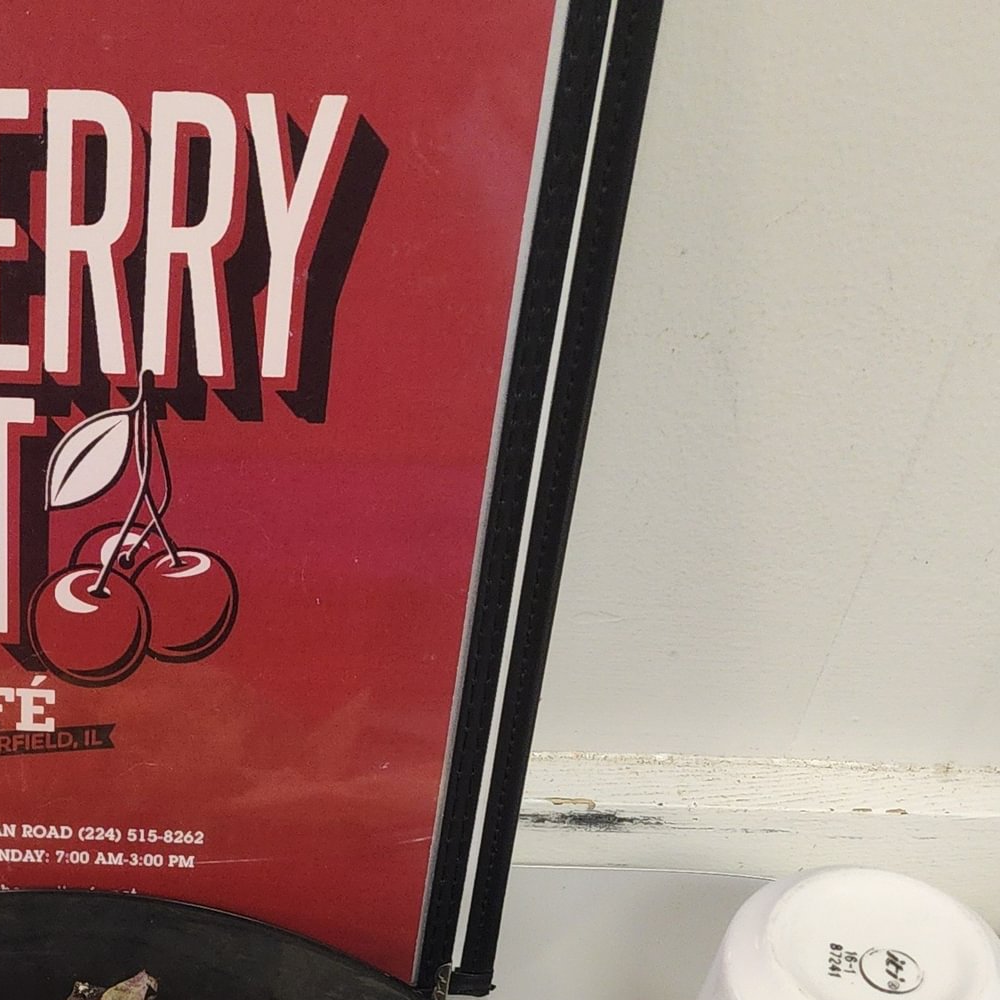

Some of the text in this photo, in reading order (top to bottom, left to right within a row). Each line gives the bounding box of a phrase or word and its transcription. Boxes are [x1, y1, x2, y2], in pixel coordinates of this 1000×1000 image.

[84, 729, 103, 747] IL
[21, 824, 73, 839] ROAD
[78, 826, 122, 843] (224)
[127, 829, 205, 845] 515-8262
[55, 850, 90, 865] 7:00
[94, 852, 164, 868] AM-3:00
[168, 854, 195, 869] PM
